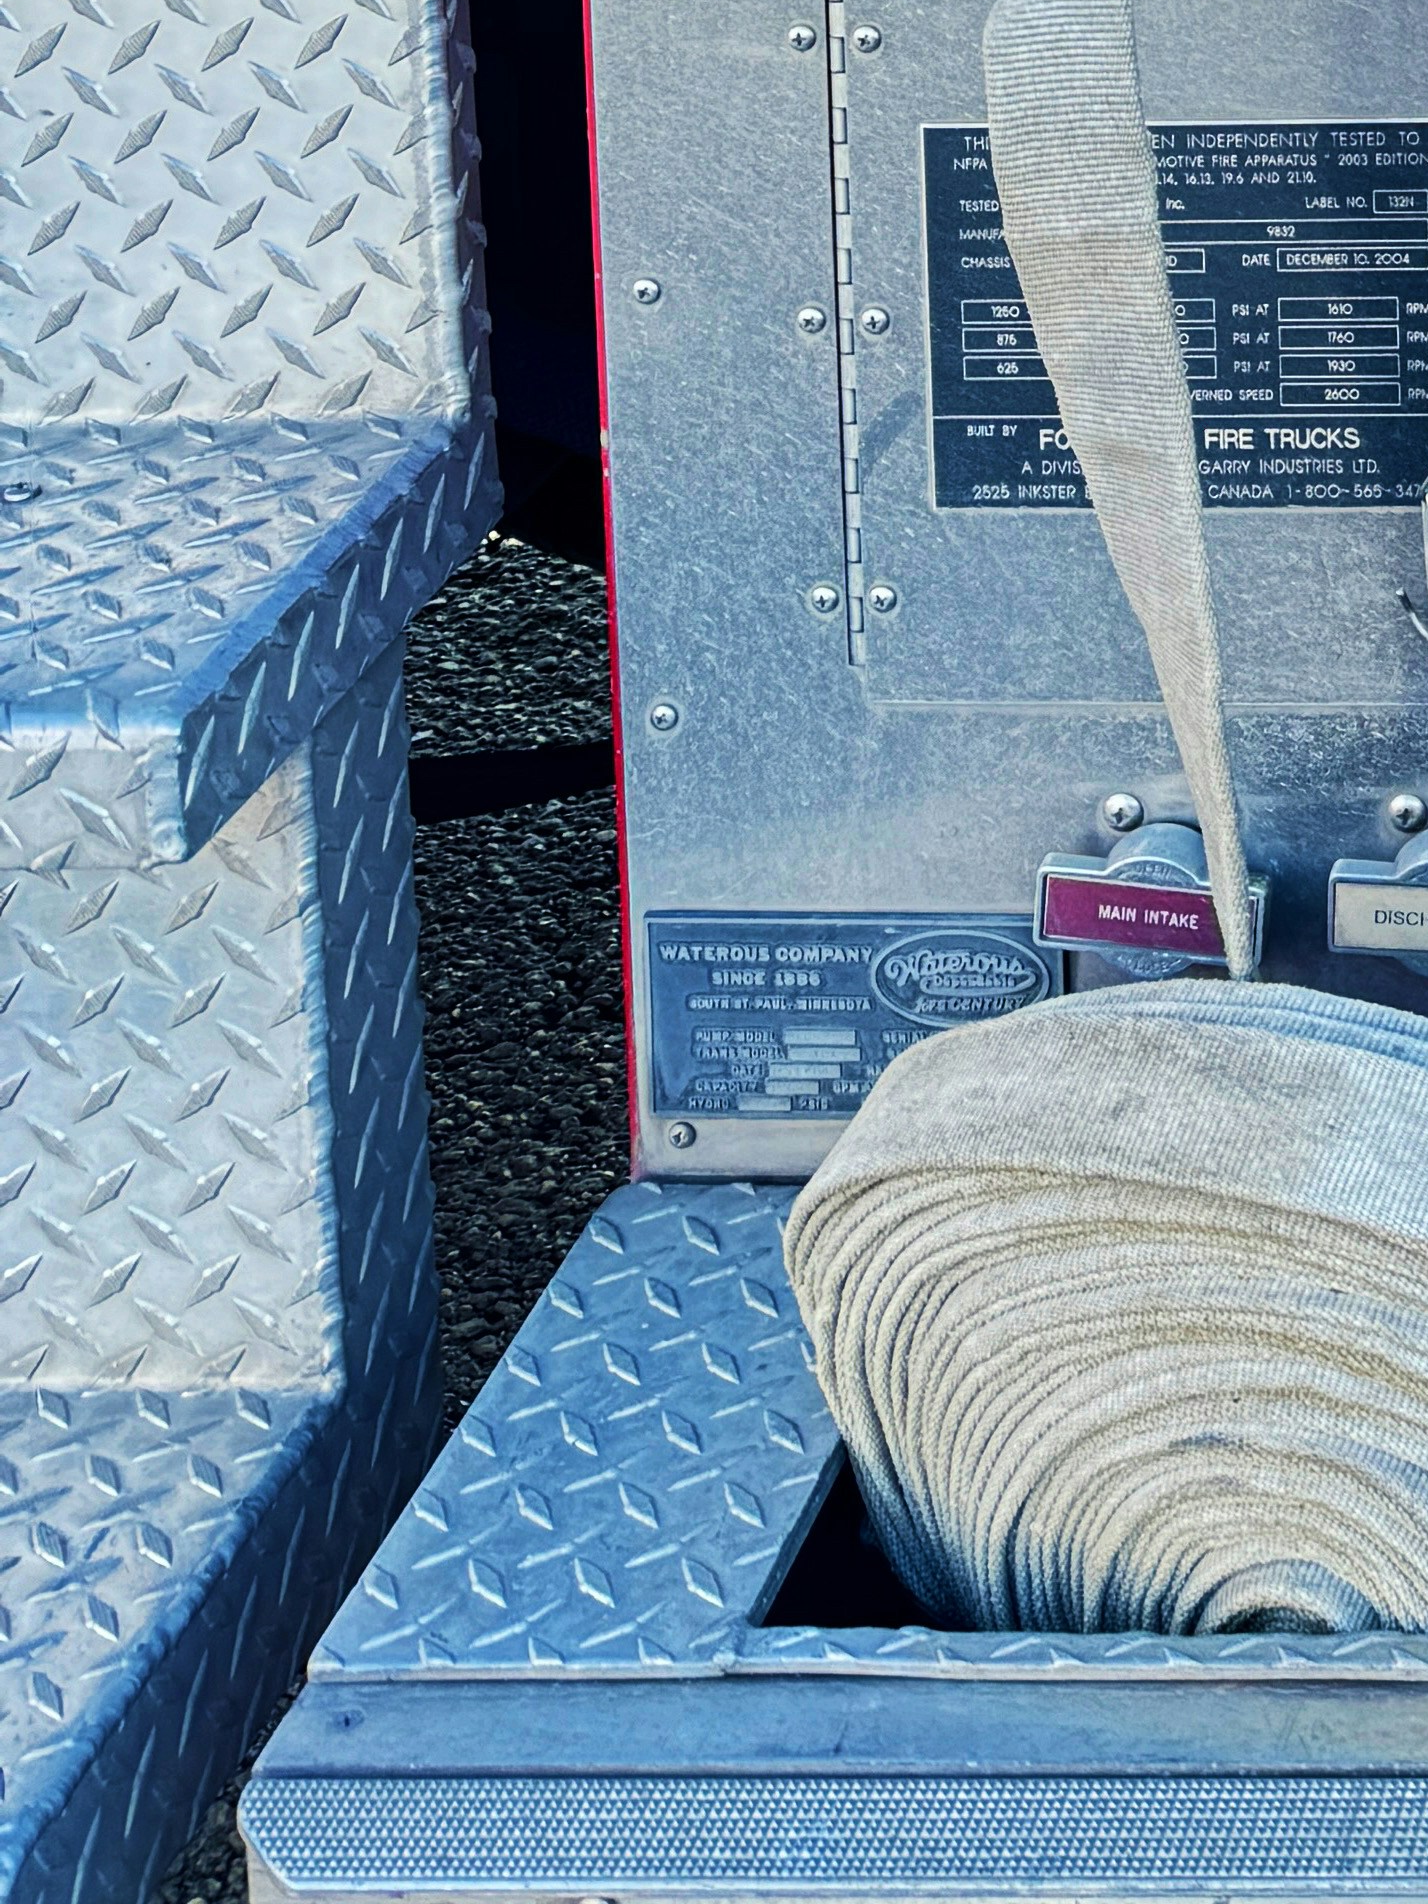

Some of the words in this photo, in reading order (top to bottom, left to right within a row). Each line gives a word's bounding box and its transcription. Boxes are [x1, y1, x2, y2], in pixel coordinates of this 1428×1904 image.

[1205, 428, 1253, 450] FIRE
[1264, 428, 1361, 450] TRUCKS
[1198, 459, 1251, 475] GARRY
[1259, 458, 1344, 474] INDUSTRIES
[1353, 458, 1381, 474] LTD.
[659, 945, 769, 962] WATEROUS
[775, 945, 872, 962] COMPANY
